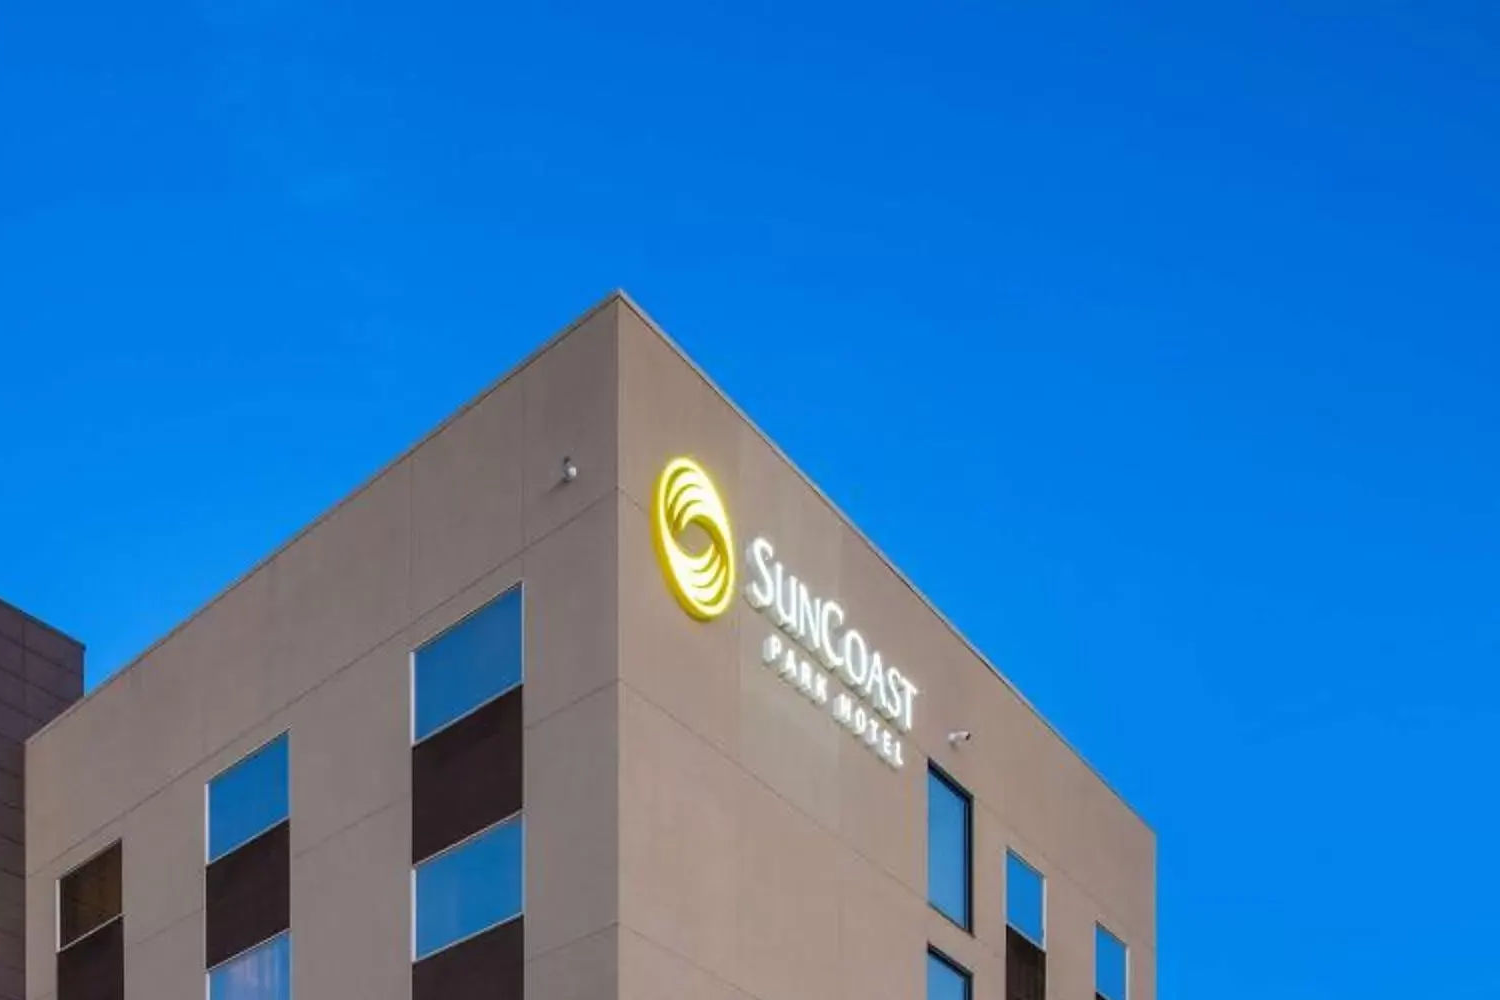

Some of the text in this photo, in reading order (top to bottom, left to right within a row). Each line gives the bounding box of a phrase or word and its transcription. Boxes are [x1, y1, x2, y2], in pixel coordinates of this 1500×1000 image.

[747, 537, 918, 732] SUNCOAST
[763, 634, 903, 767] PARK HOTEL
